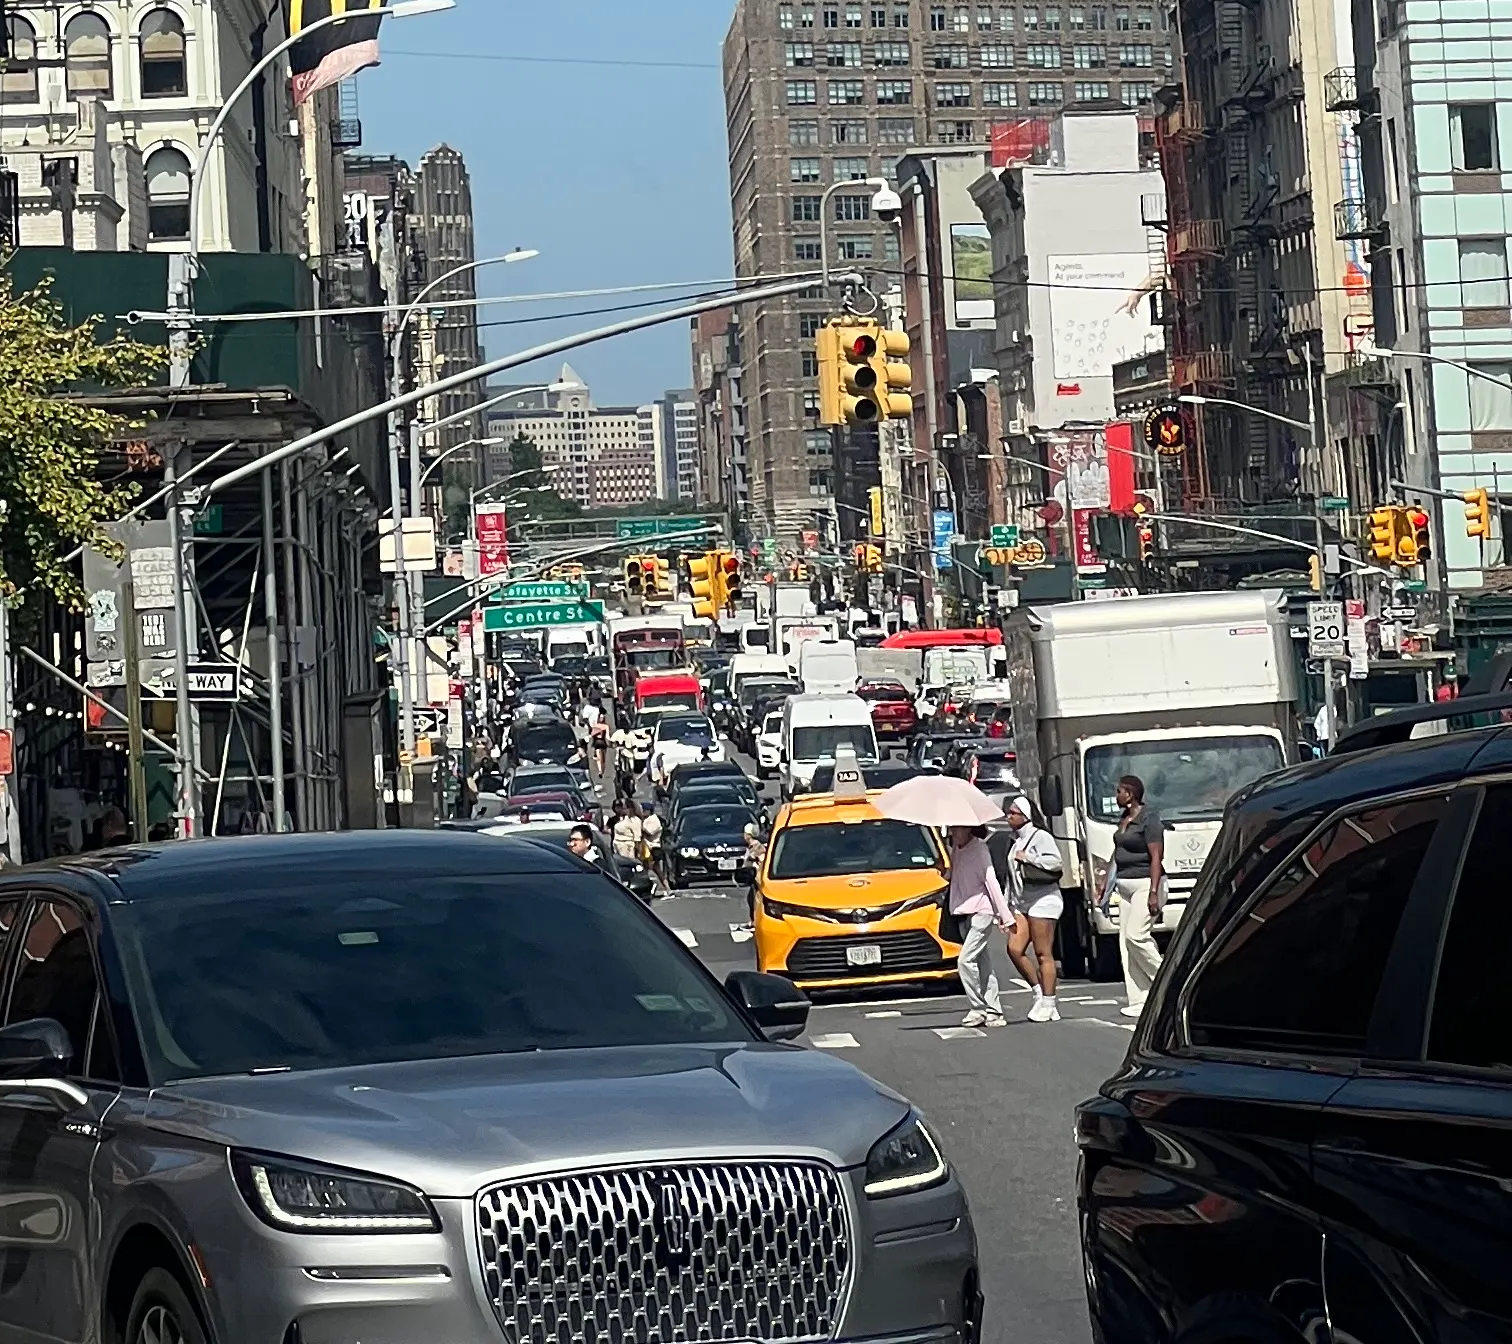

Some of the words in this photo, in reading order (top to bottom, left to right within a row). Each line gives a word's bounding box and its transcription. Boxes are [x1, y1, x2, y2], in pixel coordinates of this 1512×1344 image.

[503, 585, 562, 598] afayette
[503, 609, 562, 625] Centre
[566, 606, 584, 620] St
[1312, 605, 1340, 614] SPEED
[1313, 624, 1341, 641] 20
